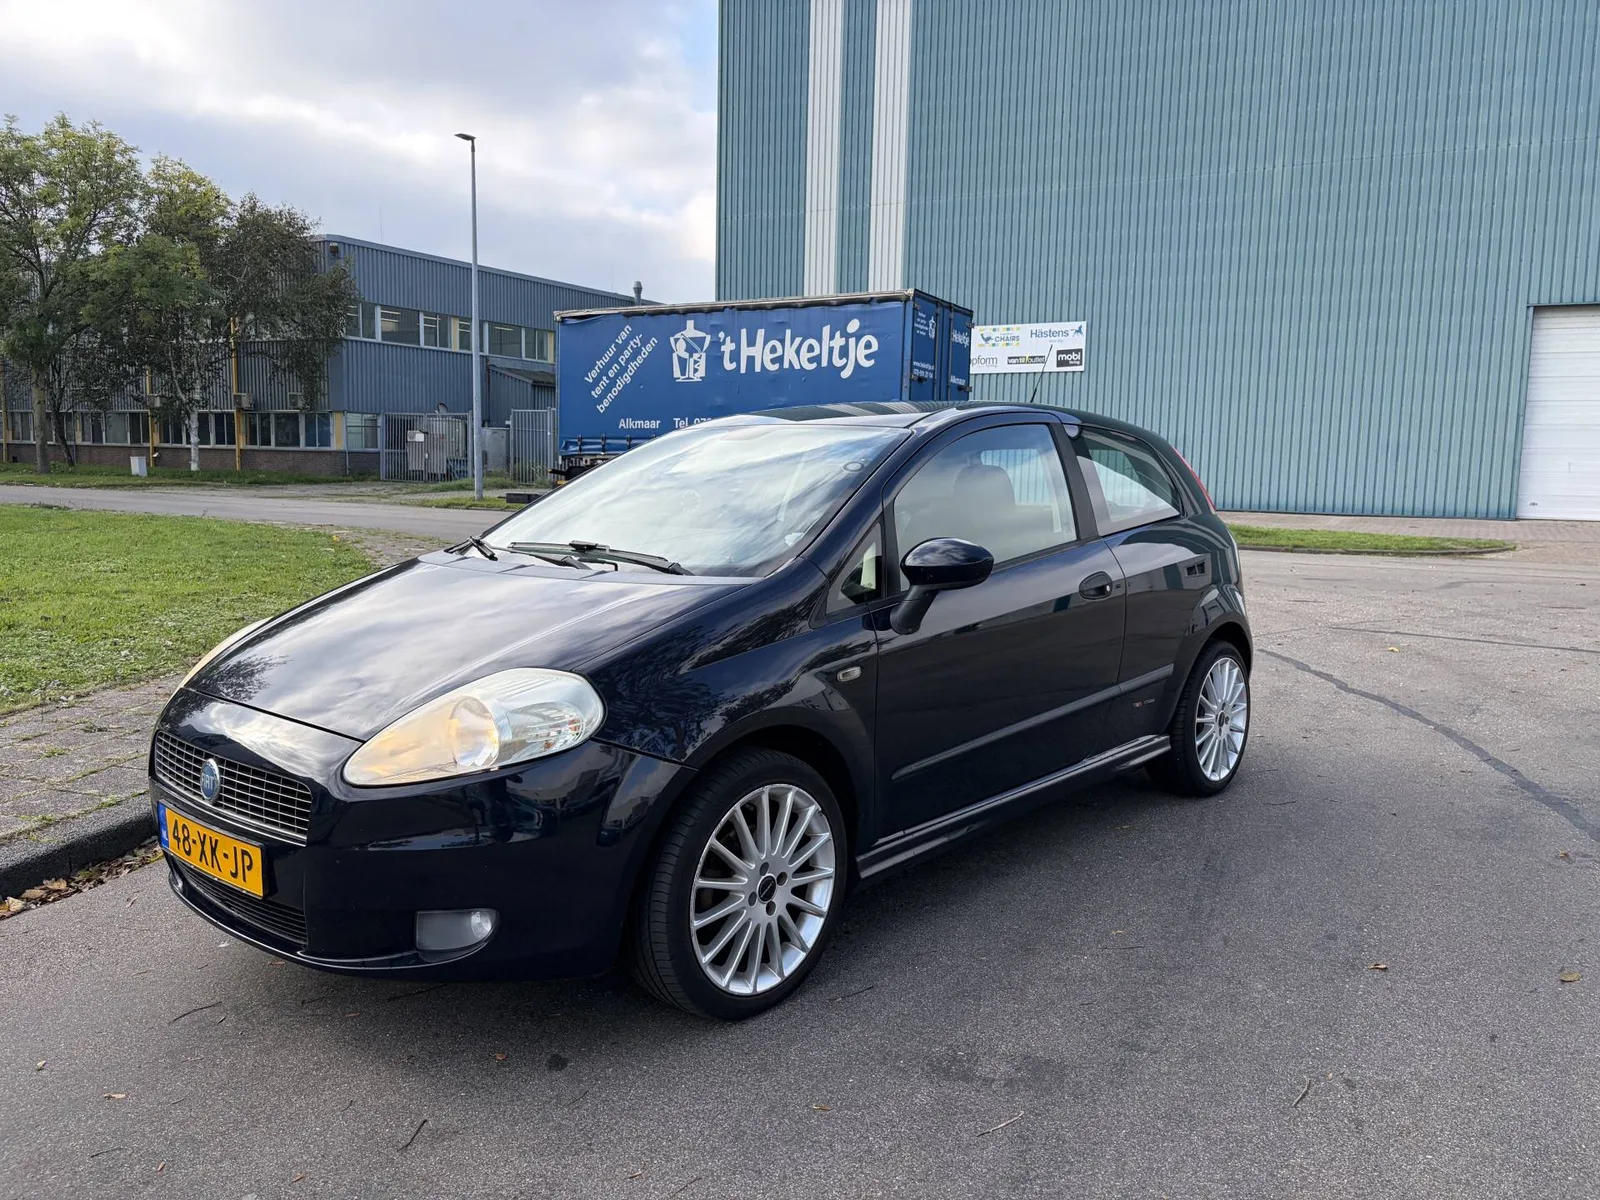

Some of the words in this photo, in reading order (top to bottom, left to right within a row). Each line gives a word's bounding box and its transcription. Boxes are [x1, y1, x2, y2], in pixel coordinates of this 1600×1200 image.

[584, 343, 617, 383] Verhuur
[615, 324, 632, 345] van
[740, 318, 879, 379] Hekeltje
[970, 355, 998, 367] pform
[1030, 328, 1069, 338] Hästens
[1057, 351, 1081, 361] mobi
[591, 375, 610, 398] tent
[608, 363, 620, 378] en
[618, 333, 643, 366] party-
[596, 336, 658, 413] benodigdheden
[618, 417, 661, 429] Alkmaar
[172, 818, 253, 883] 48-XK-JP
